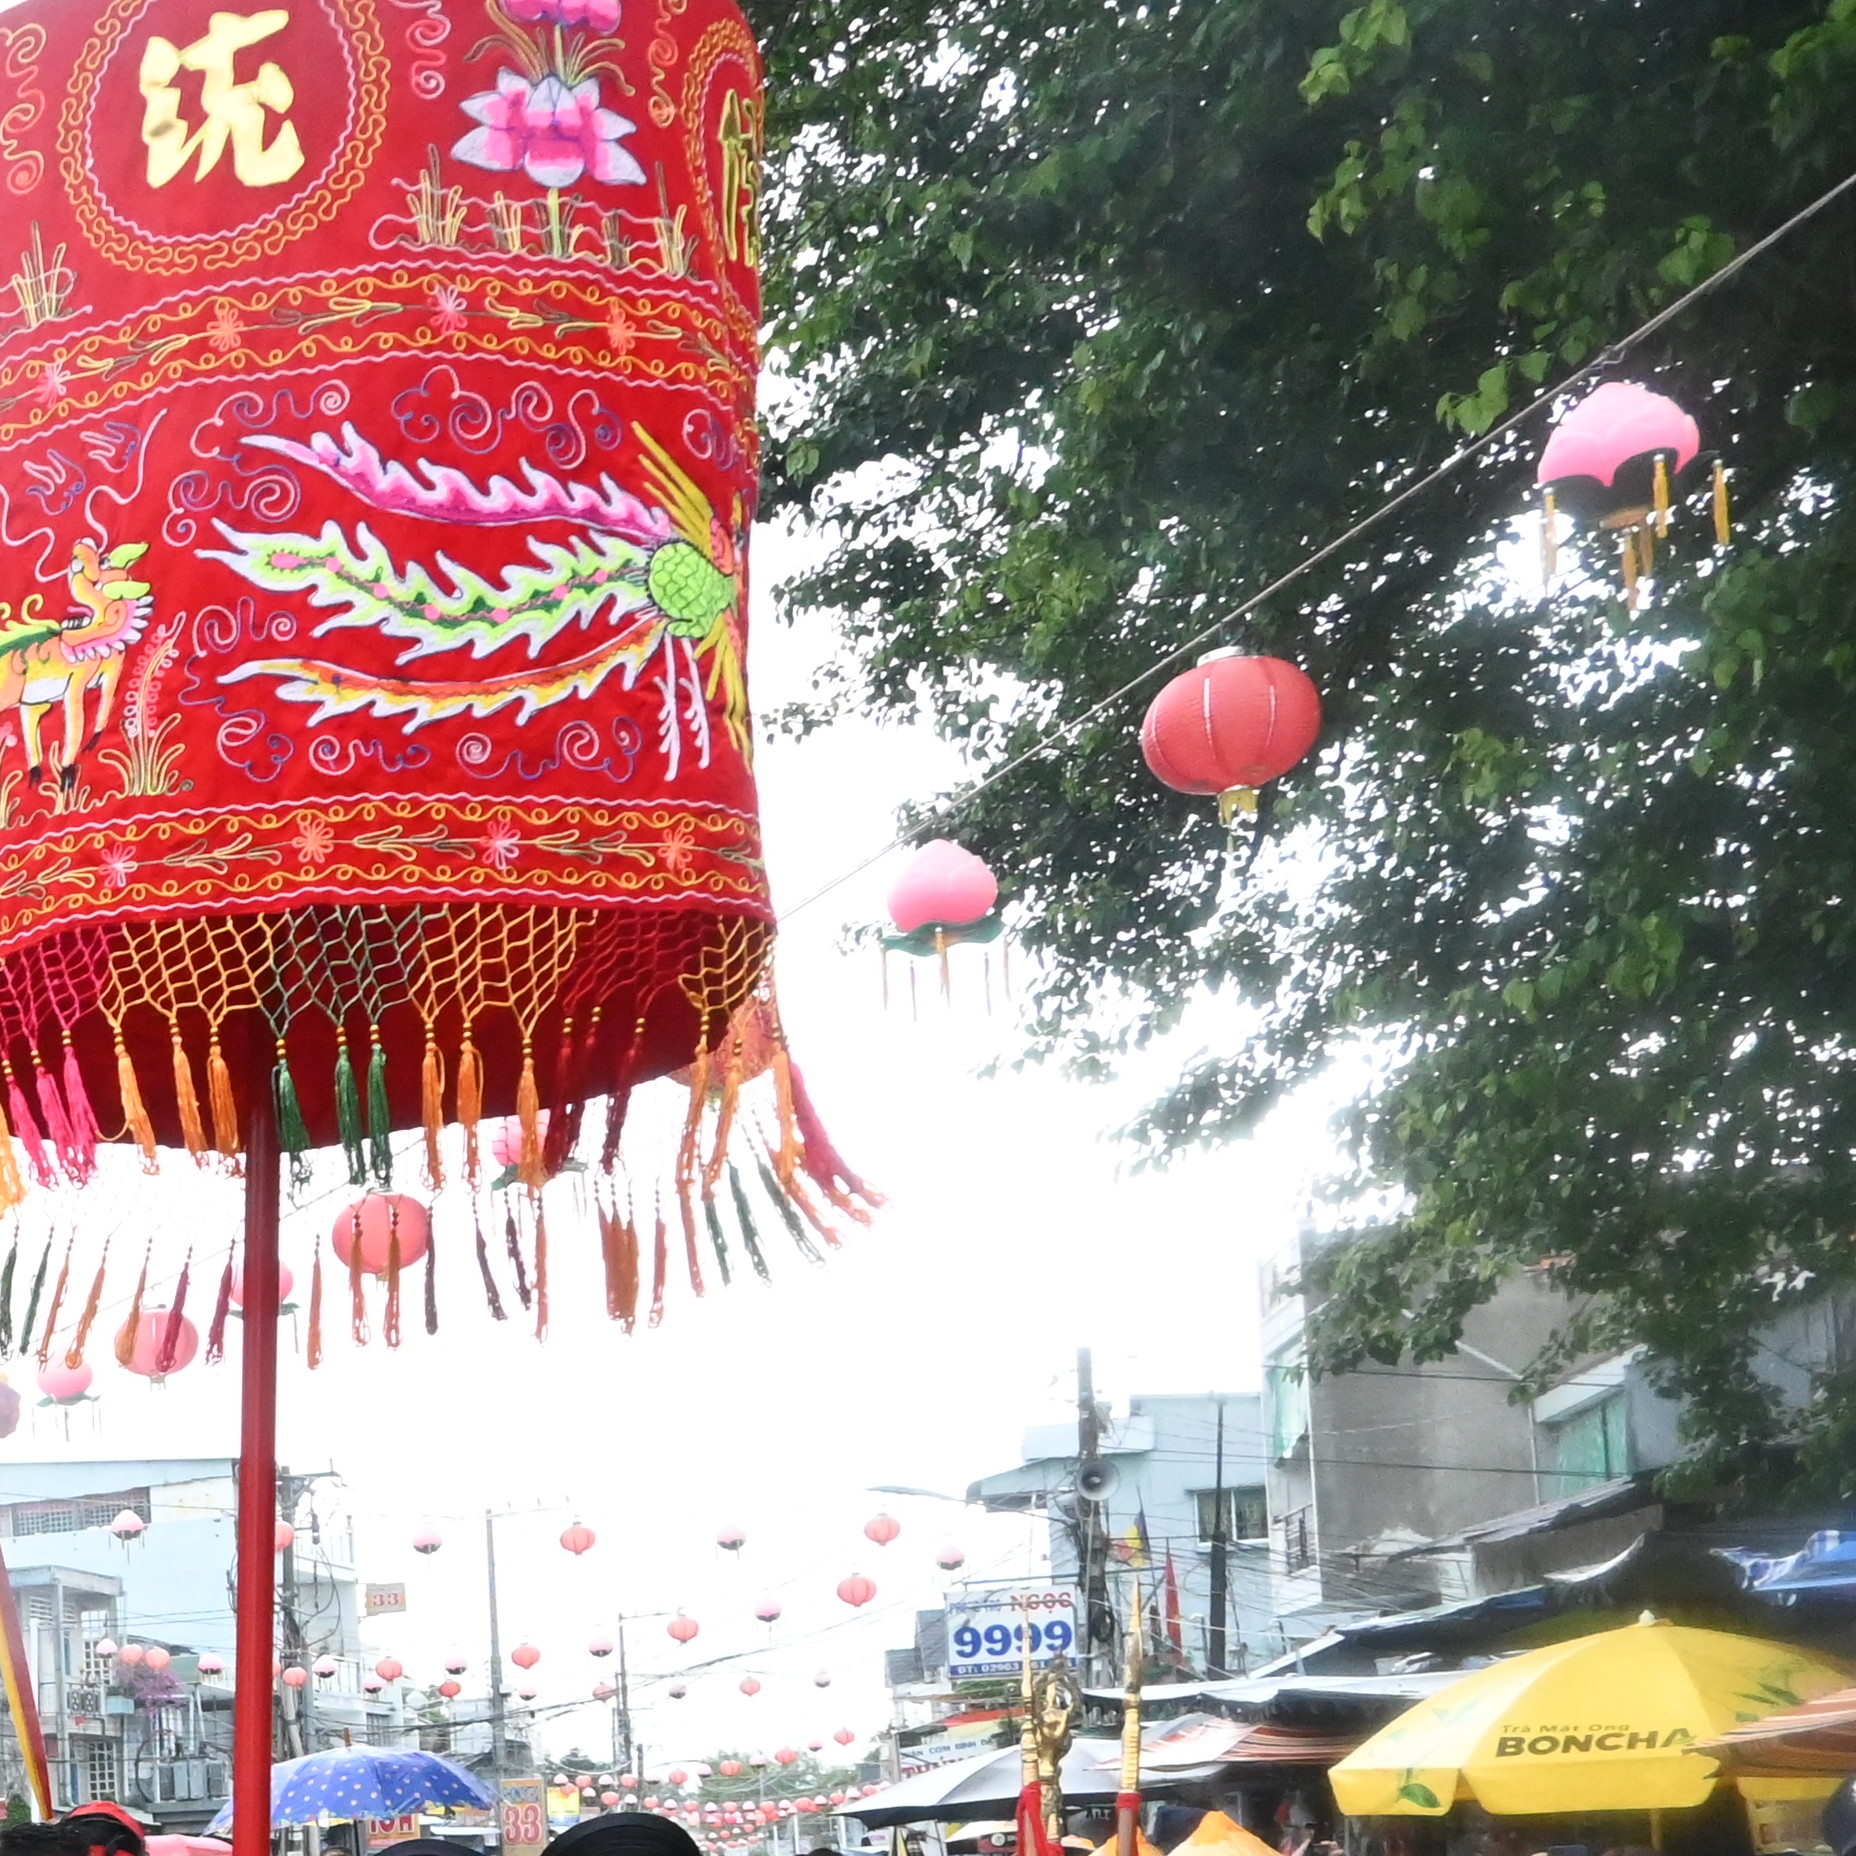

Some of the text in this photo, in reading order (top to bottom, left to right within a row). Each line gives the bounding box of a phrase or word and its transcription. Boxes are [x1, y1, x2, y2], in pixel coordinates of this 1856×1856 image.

[954, 1620, 1072, 1658] 9999
[1495, 1727, 1696, 1757] BONCHA
[504, 1804, 542, 1844] 33
